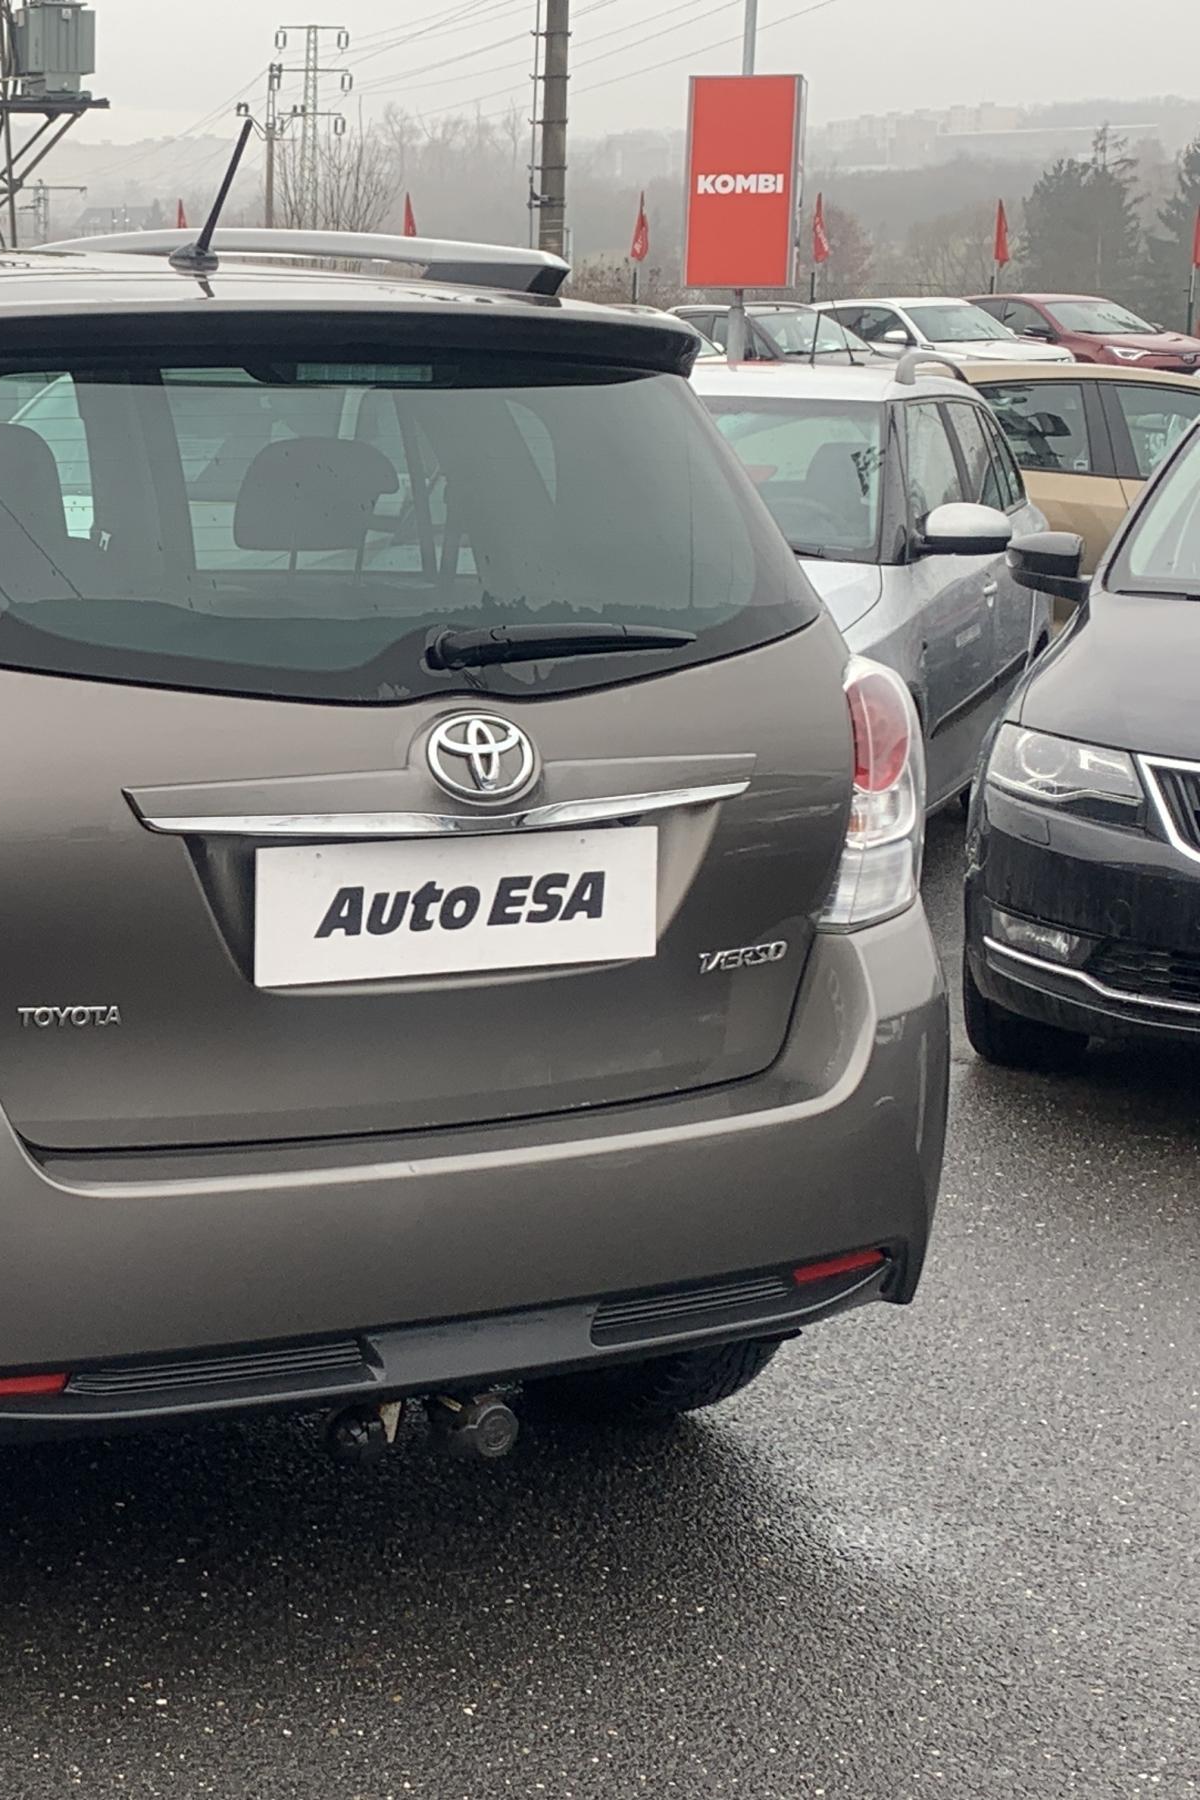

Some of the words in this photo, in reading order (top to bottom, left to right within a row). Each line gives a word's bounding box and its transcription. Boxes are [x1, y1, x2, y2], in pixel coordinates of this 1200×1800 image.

[697, 173, 784, 194] KOMBI
[314, 881, 481, 939] Auto
[486, 870, 606, 927] ESA
[699, 940, 788, 974] VERSO
[18, 1005, 121, 1027] TOYOTA
